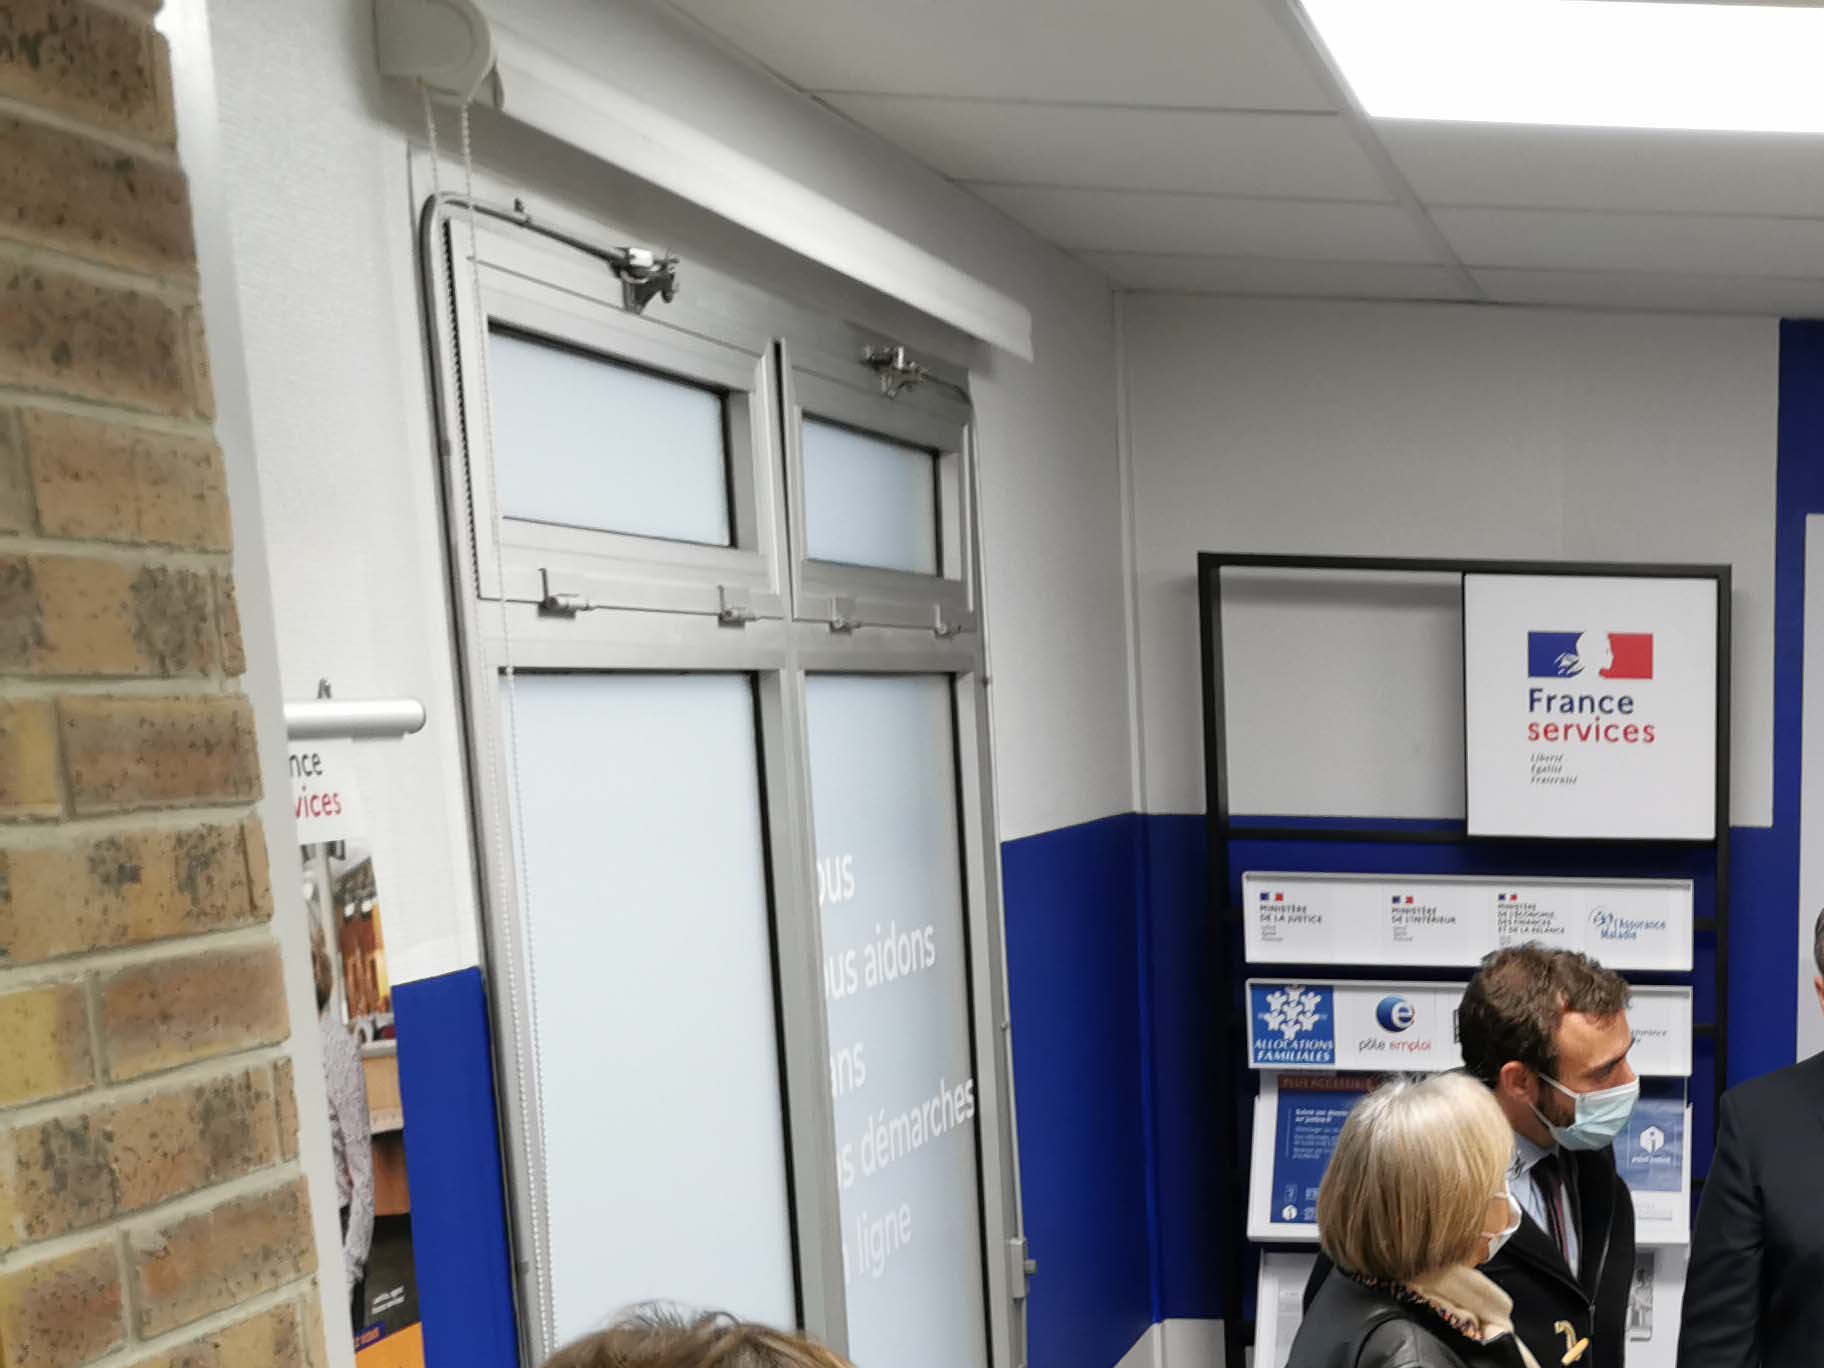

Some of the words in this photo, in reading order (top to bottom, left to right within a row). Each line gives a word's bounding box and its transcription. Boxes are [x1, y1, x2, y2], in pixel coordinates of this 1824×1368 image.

[1529, 688, 1634, 714] France
[1528, 716, 1655, 743] services
[864, 920, 936, 988] aidons
[1254, 1039, 1333, 1050] ALLOCATIONS
[1257, 1051, 1331, 1062] FAMILIALES
[1359, 1037, 1386, 1055] pôle
[1390, 1039, 1432, 1055] emploi
[862, 1078, 975, 1176] démarches
[857, 1203, 911, 1279] ligne
